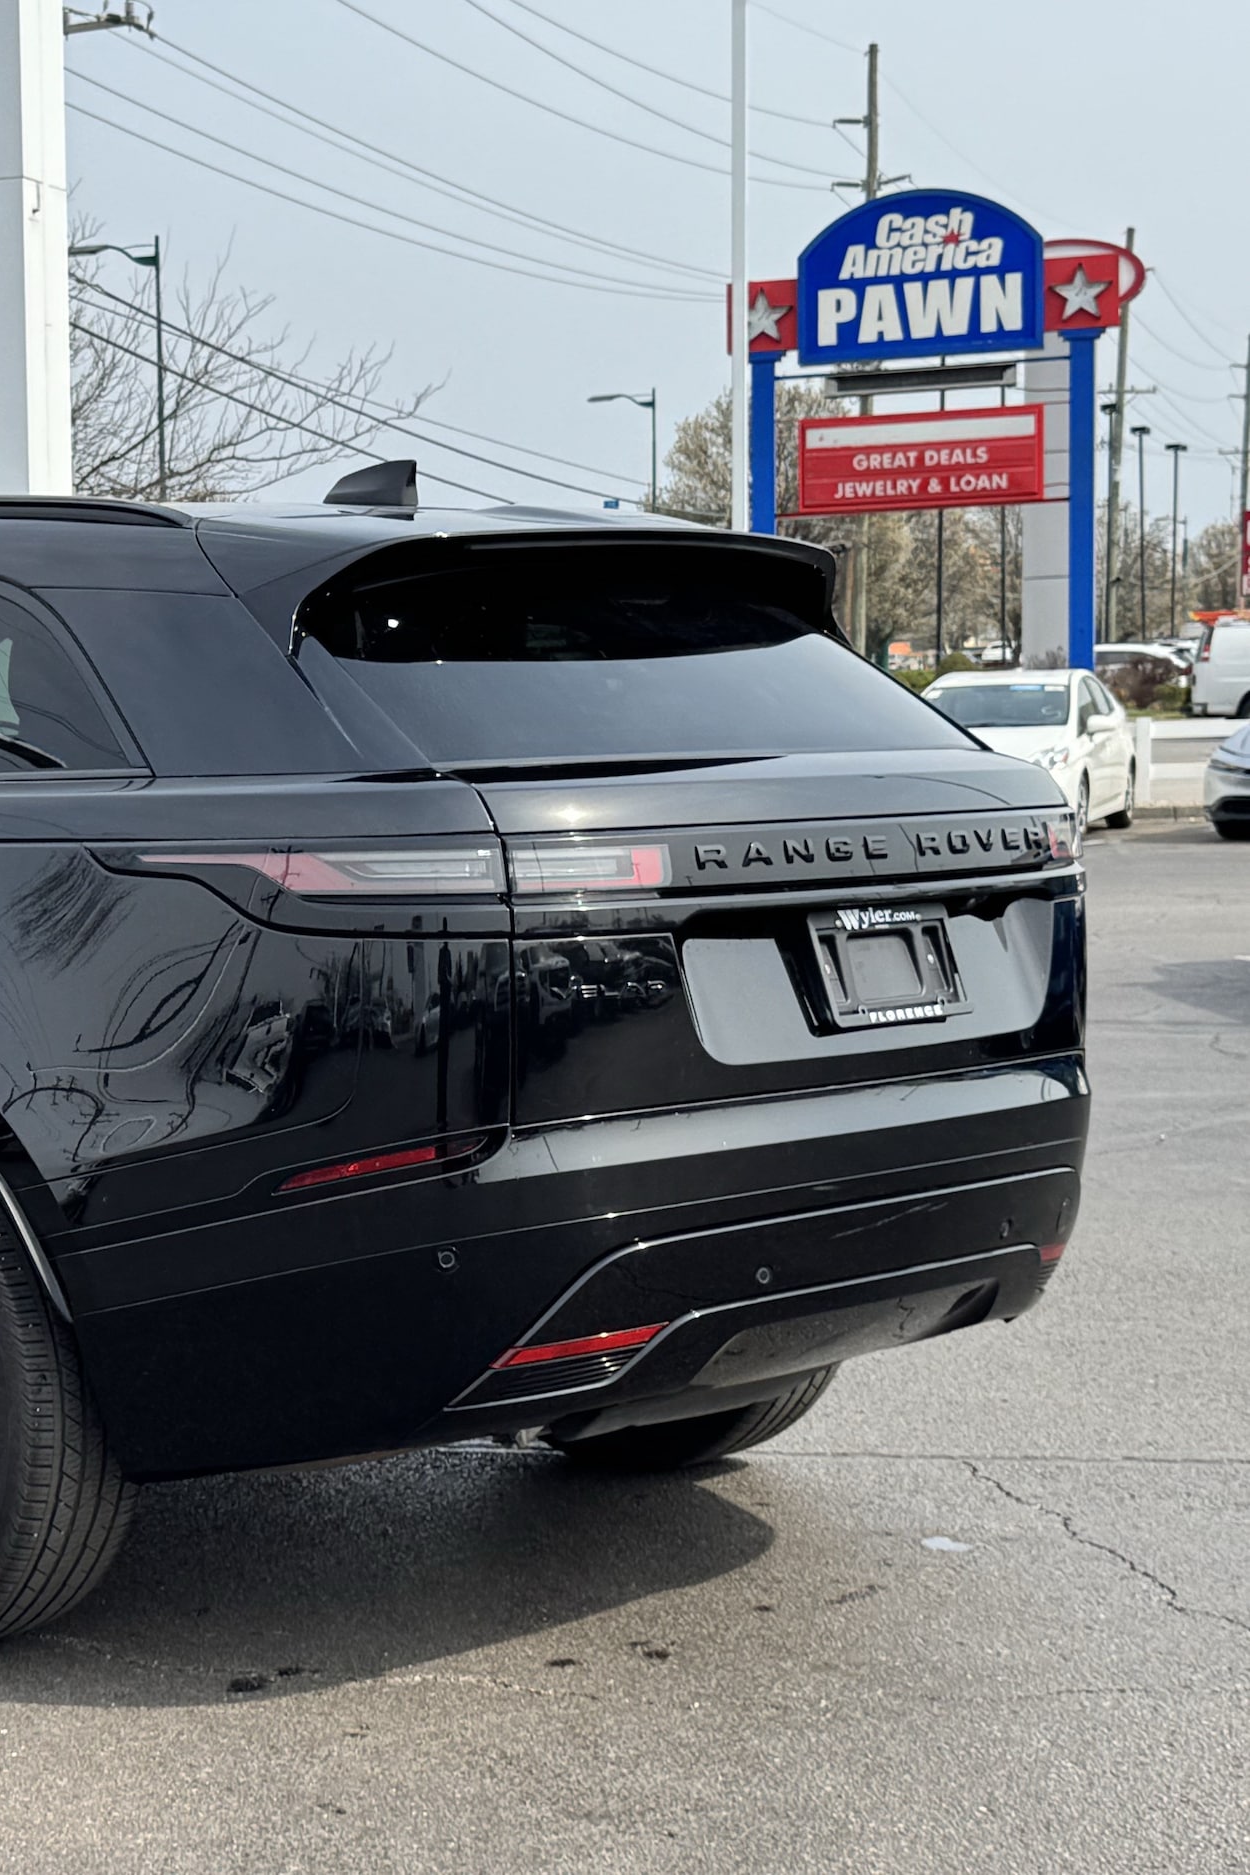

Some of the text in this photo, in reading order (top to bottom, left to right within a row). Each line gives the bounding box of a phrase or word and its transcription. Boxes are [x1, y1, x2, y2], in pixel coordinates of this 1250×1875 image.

[875, 206, 975, 249] Cash
[838, 236, 1004, 281] America
[816, 272, 1024, 348] PAWN
[852, 446, 989, 471] GREAT DEALS
[833, 472, 1009, 500] JEWELRY & LOAN
[694, 825, 1044, 870] RANGE ROVER
[869, 1004, 944, 1024] FLORENCE
